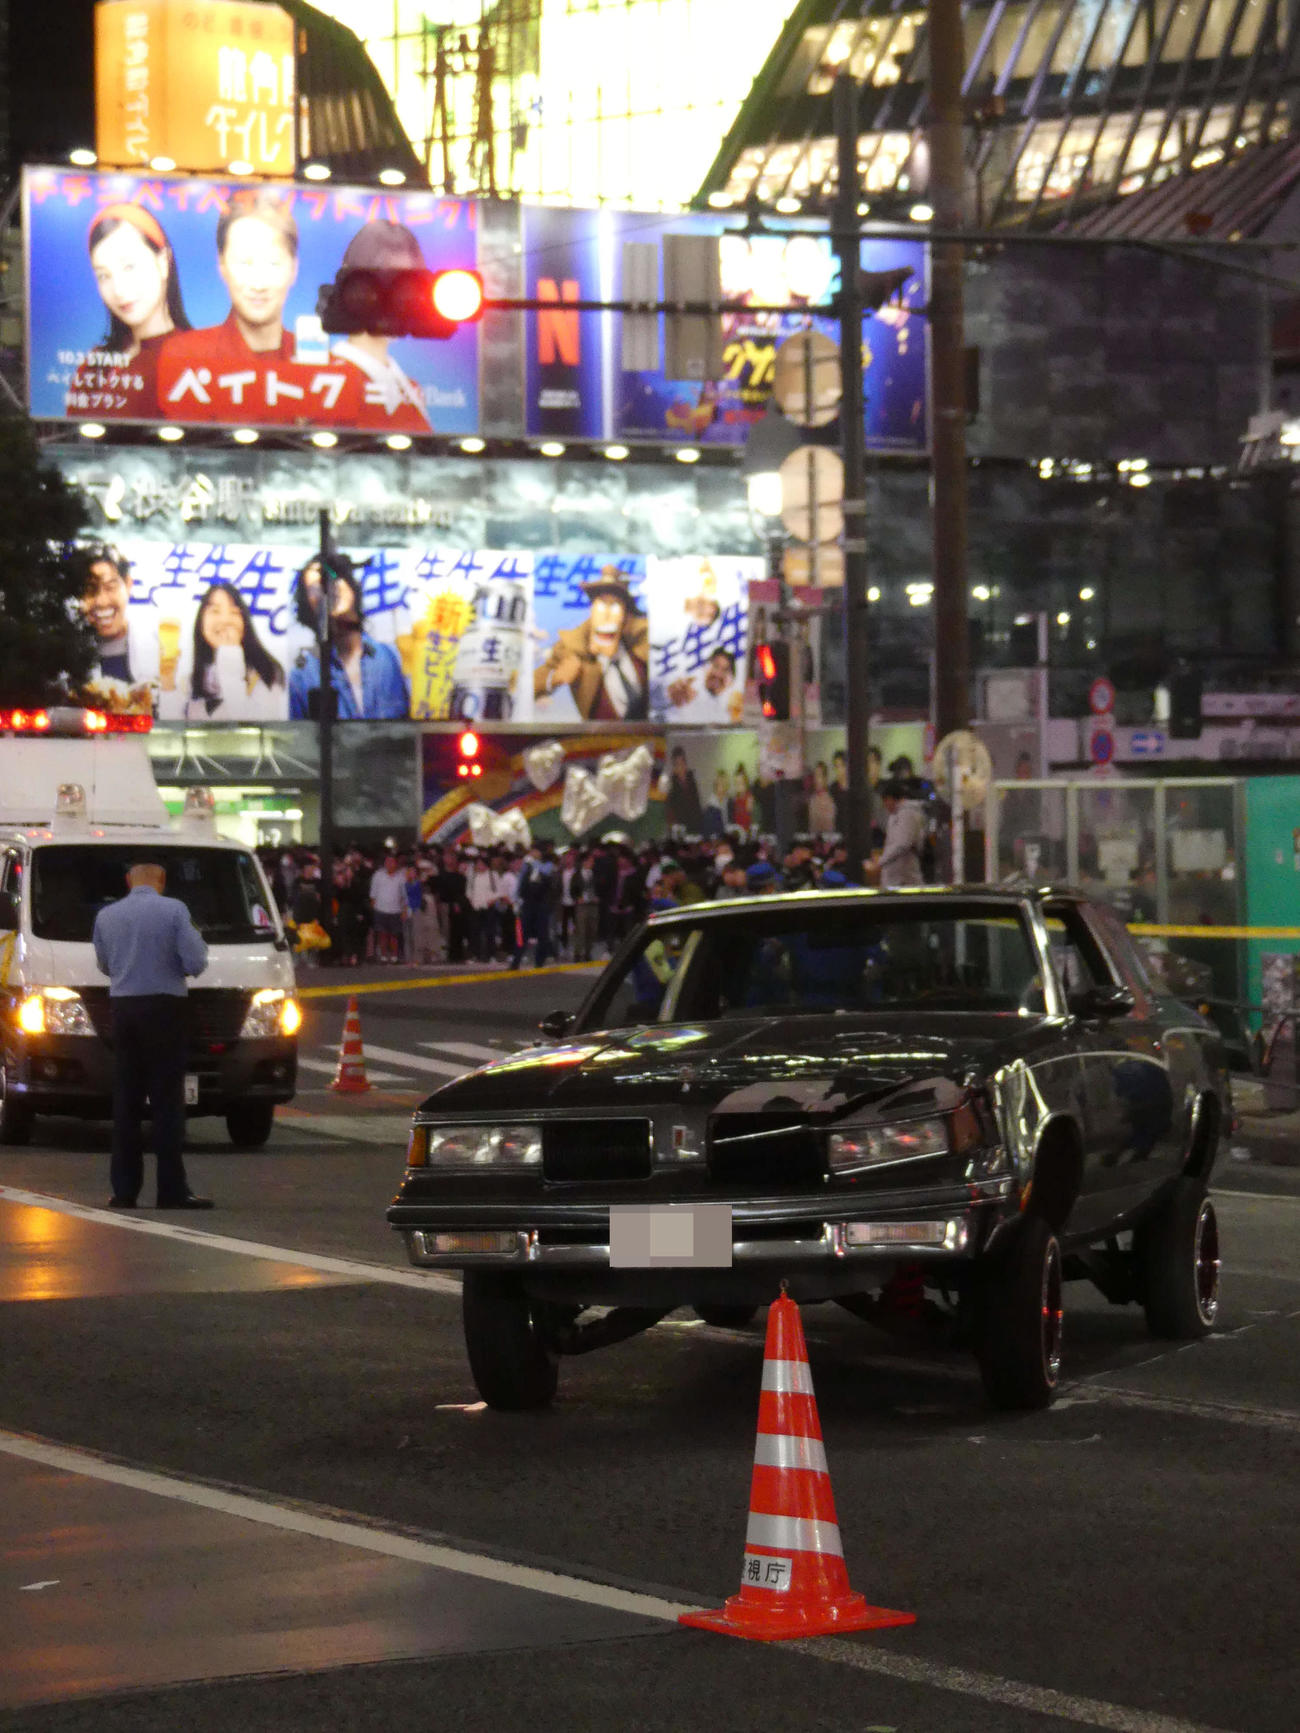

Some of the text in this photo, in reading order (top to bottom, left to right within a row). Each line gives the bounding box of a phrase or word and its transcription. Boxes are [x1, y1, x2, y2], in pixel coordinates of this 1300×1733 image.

[87, 351, 132, 369] START
[166, 366, 348, 410] ペイトク
[742, 1559, 787, 1585] 視庁
